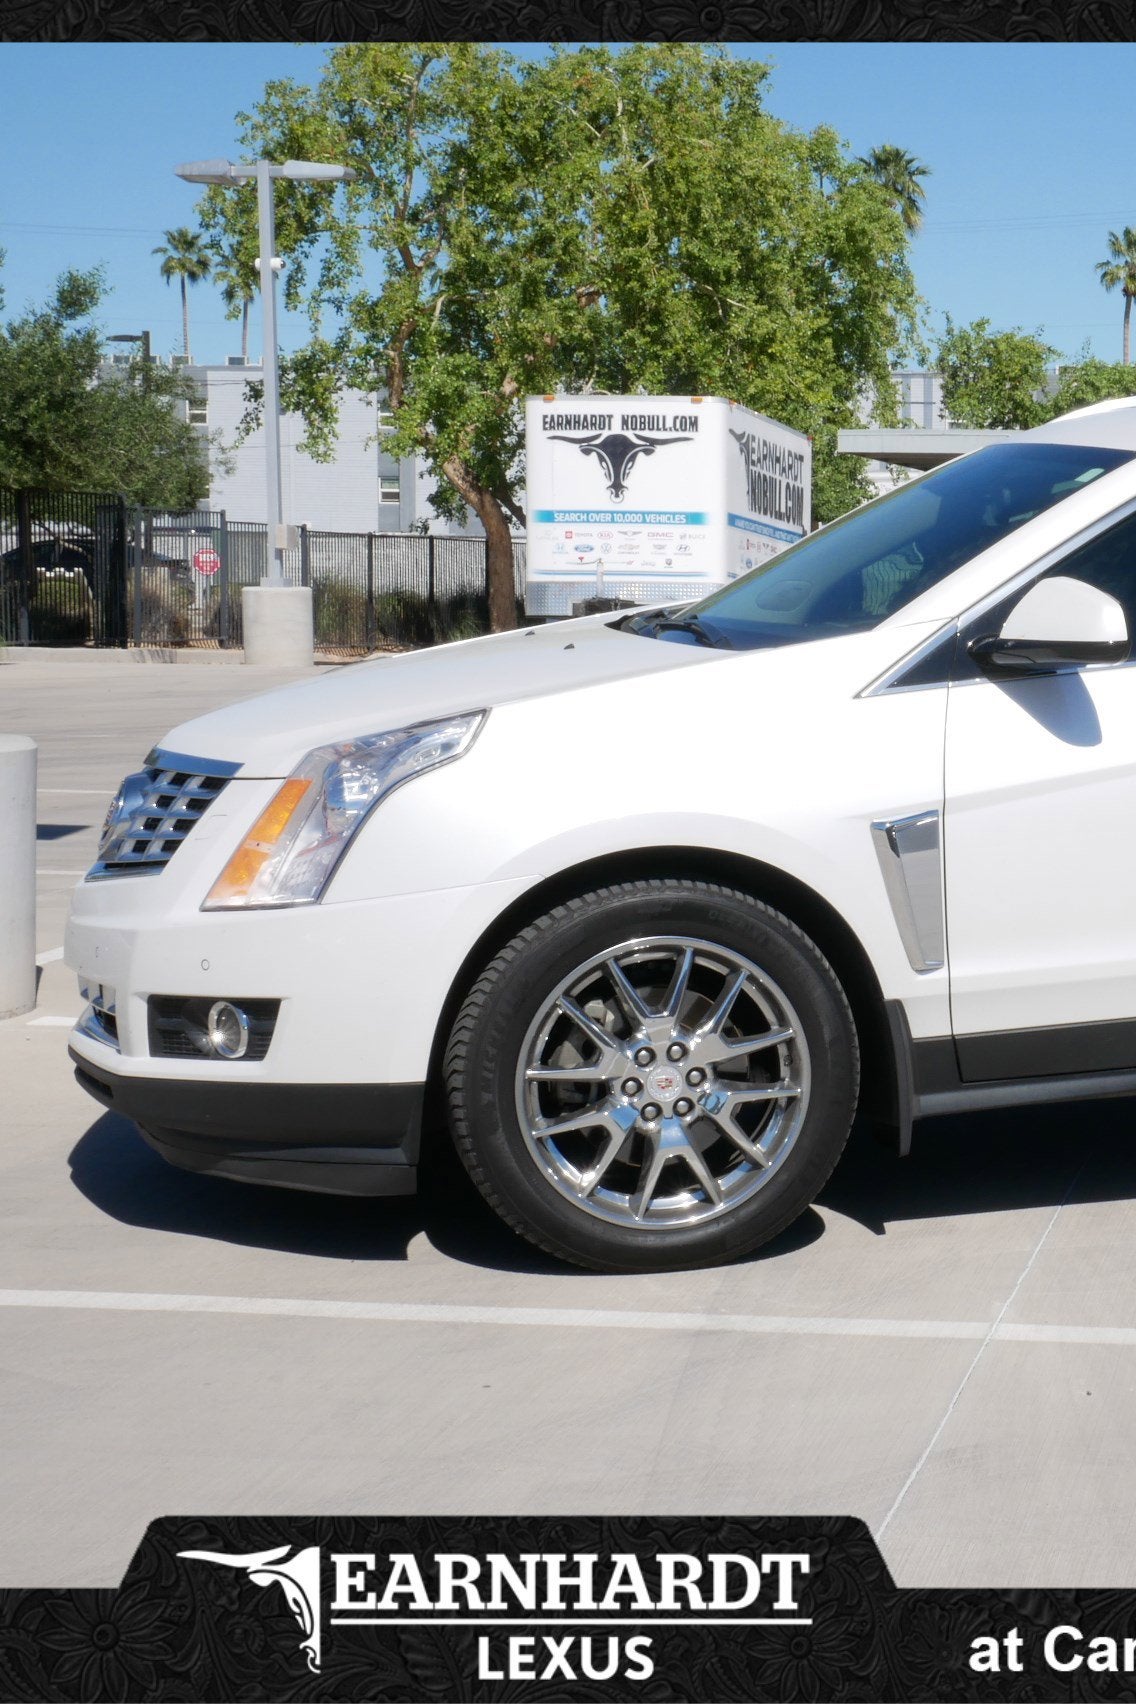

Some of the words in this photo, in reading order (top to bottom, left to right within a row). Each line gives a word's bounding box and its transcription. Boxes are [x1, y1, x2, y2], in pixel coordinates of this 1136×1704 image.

[542, 414, 614, 431] EARNHARDT
[621, 415, 698, 432] NOBULL.COM
[750, 435, 804, 484] EARNHARDT
[750, 469, 804, 527] NOBULL.COM
[554, 512, 586, 522] SEARCH
[588, 513, 611, 522] OVER
[645, 514, 686, 524] VEHICLES
